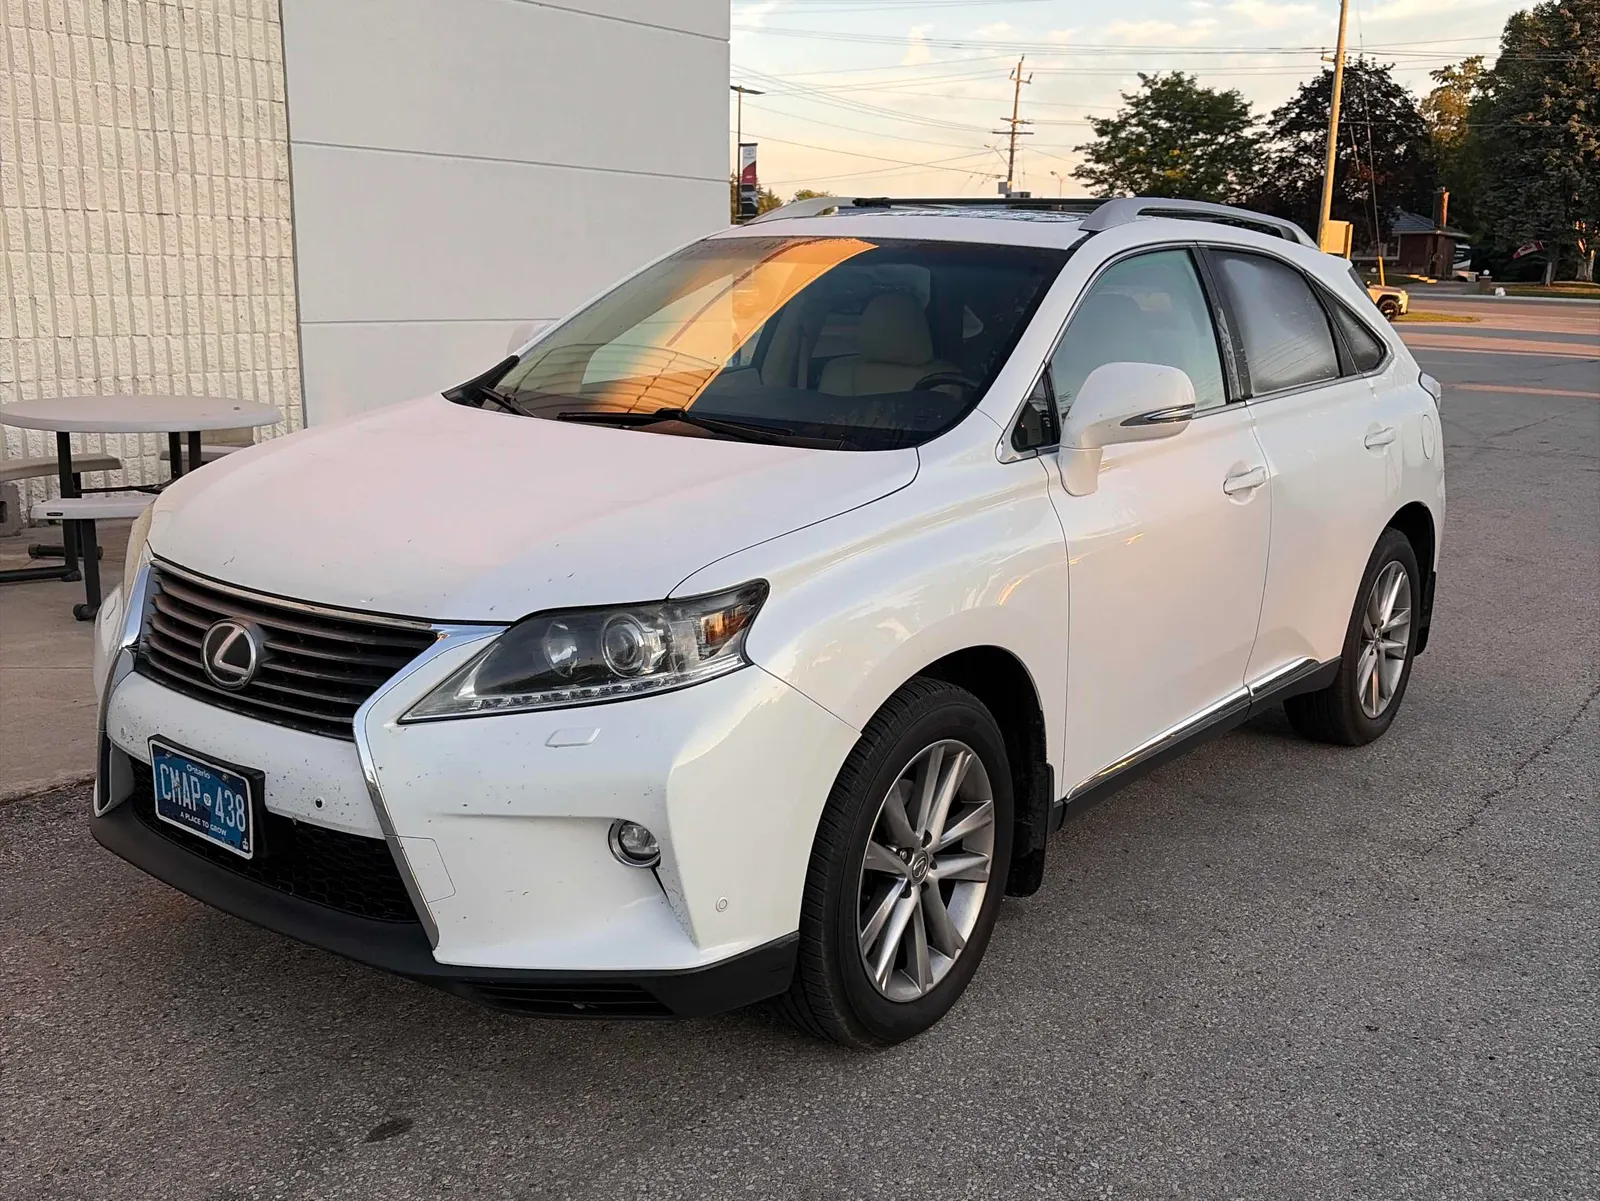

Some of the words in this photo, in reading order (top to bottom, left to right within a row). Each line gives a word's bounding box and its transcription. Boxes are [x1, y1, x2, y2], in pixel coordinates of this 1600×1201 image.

[187, 764, 210, 779] Ontario
[160, 763, 201, 812] CMAP
[215, 786, 246, 833] 438
[185, 812, 201, 826] PLACE
[202, 820, 210, 829] TO
[210, 824, 227, 837] GROW
